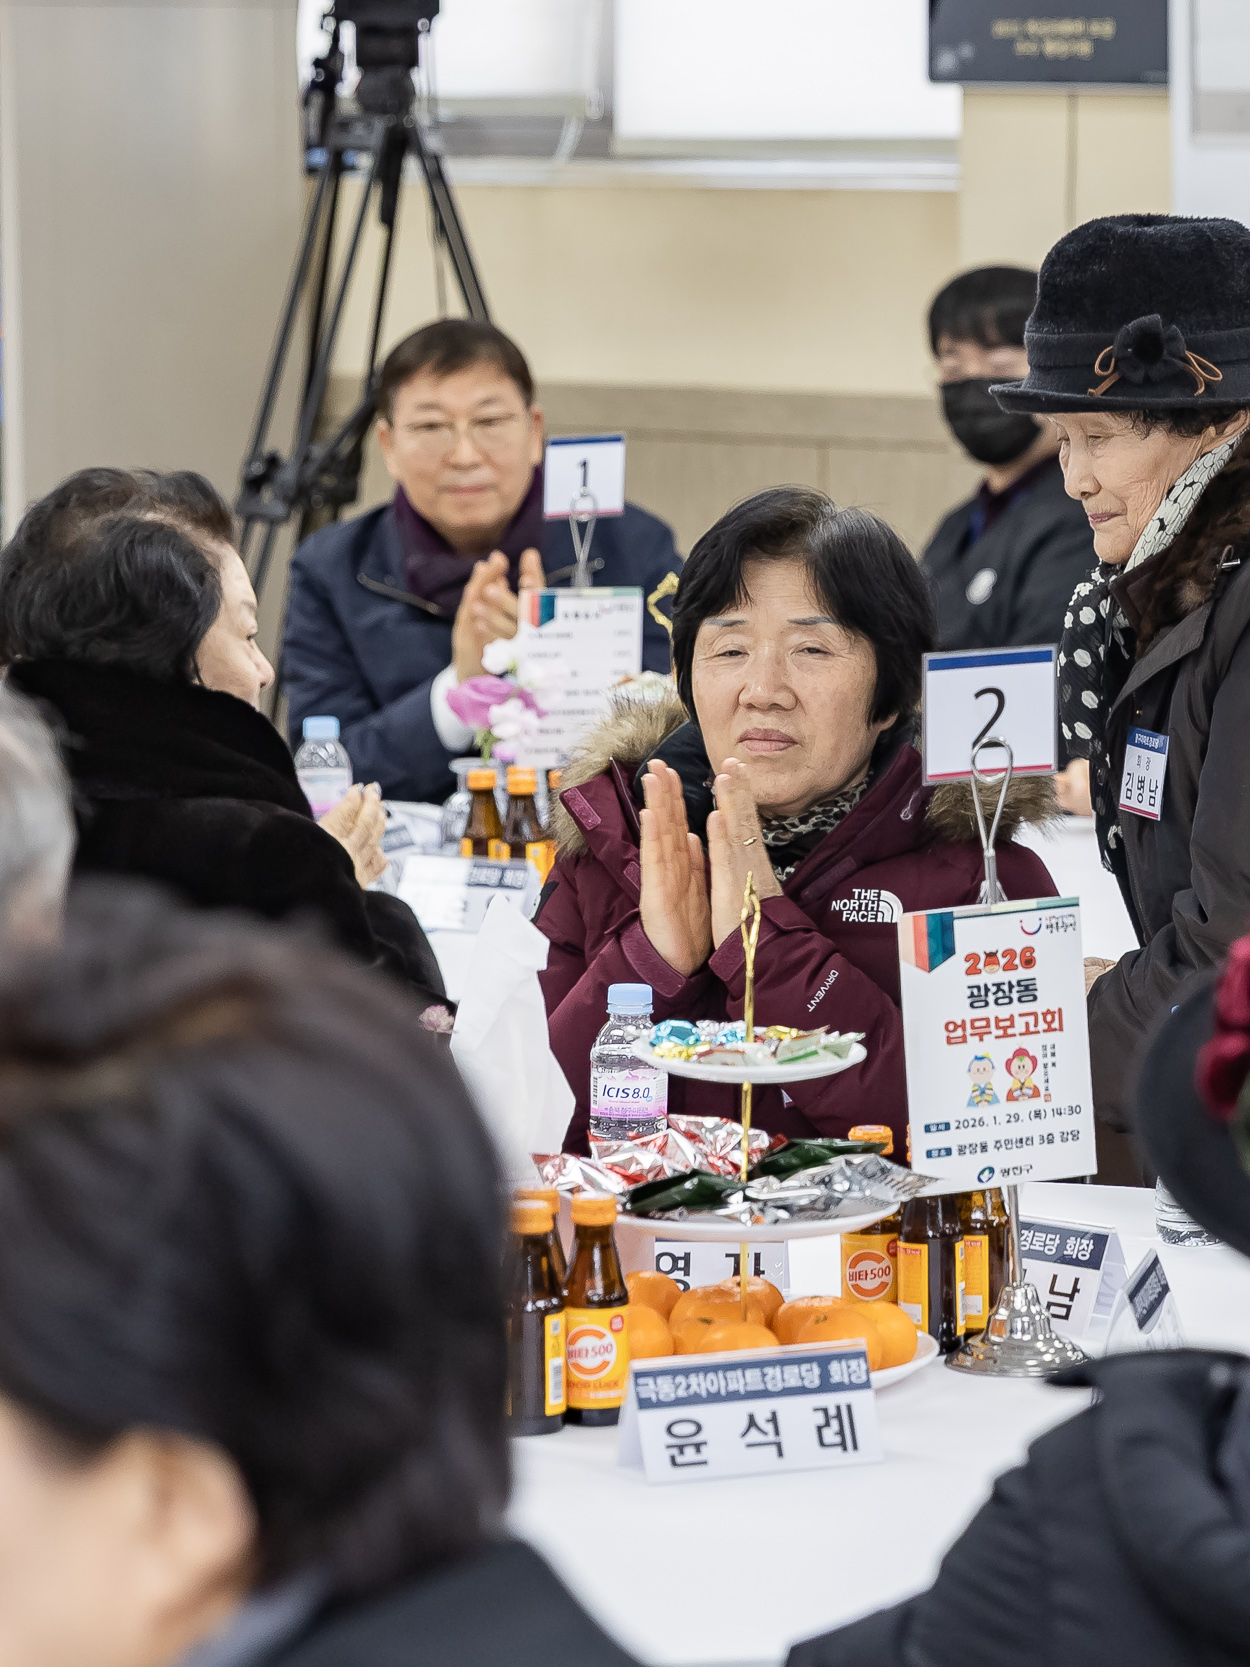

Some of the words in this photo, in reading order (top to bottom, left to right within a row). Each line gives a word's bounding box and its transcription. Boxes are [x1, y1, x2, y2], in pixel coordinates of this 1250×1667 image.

[577, 459, 589, 489] 1
[972, 687, 1006, 749] 2
[831, 899, 878, 912] NORTH
[852, 888, 880, 900] THE
[842, 910, 877, 923] FACE
[806, 969, 840, 1013] DRYVENT
[967, 977, 1039, 1010] 광장동
[944, 1008, 1064, 1046] 업무보고회
[632, 1087, 650, 1099] 8.0
[955, 1116, 989, 1130] 2026.
[1051, 1104, 1082, 1118] 14:30
[1063, 1236, 1095, 1261] 회장
[848, 1265, 891, 1282] 비타500
[1045, 1273, 1081, 1321] 남
[828, 1357, 868, 1385] 회장
